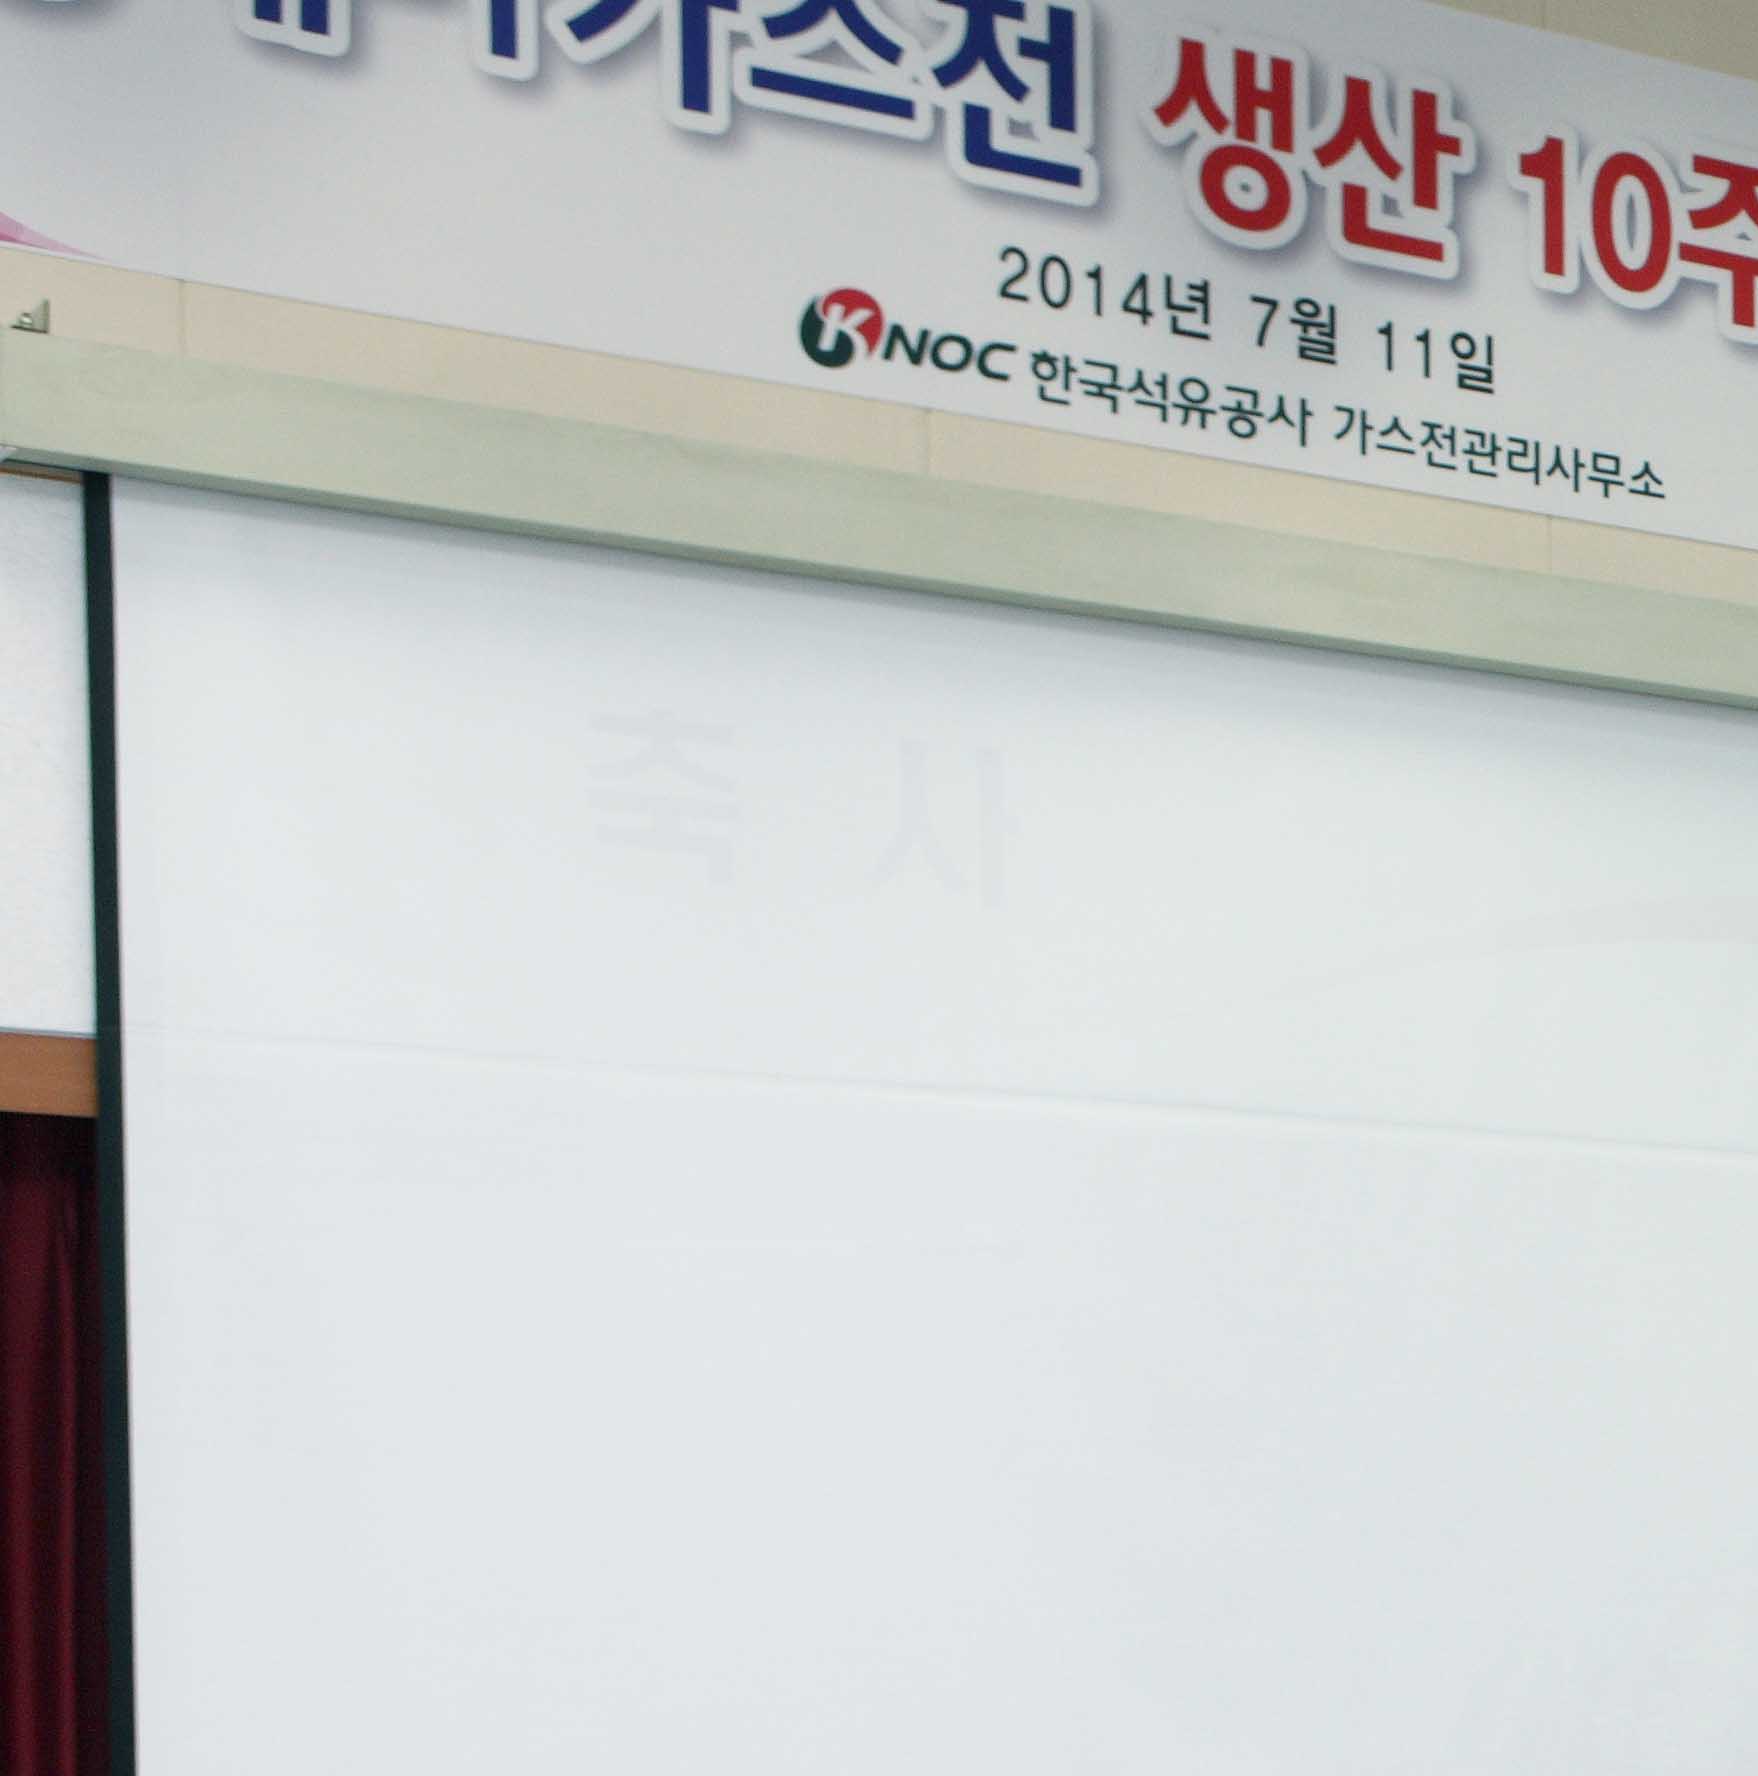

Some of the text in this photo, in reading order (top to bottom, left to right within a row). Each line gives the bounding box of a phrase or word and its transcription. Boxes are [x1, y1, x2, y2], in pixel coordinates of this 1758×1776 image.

[1157, 41, 1461, 262] 생산
[800, 288, 1666, 499] KNOC 한국석유공사 가스전관리사무소
[999, 246, 1496, 395] 2014년 7월 11일
